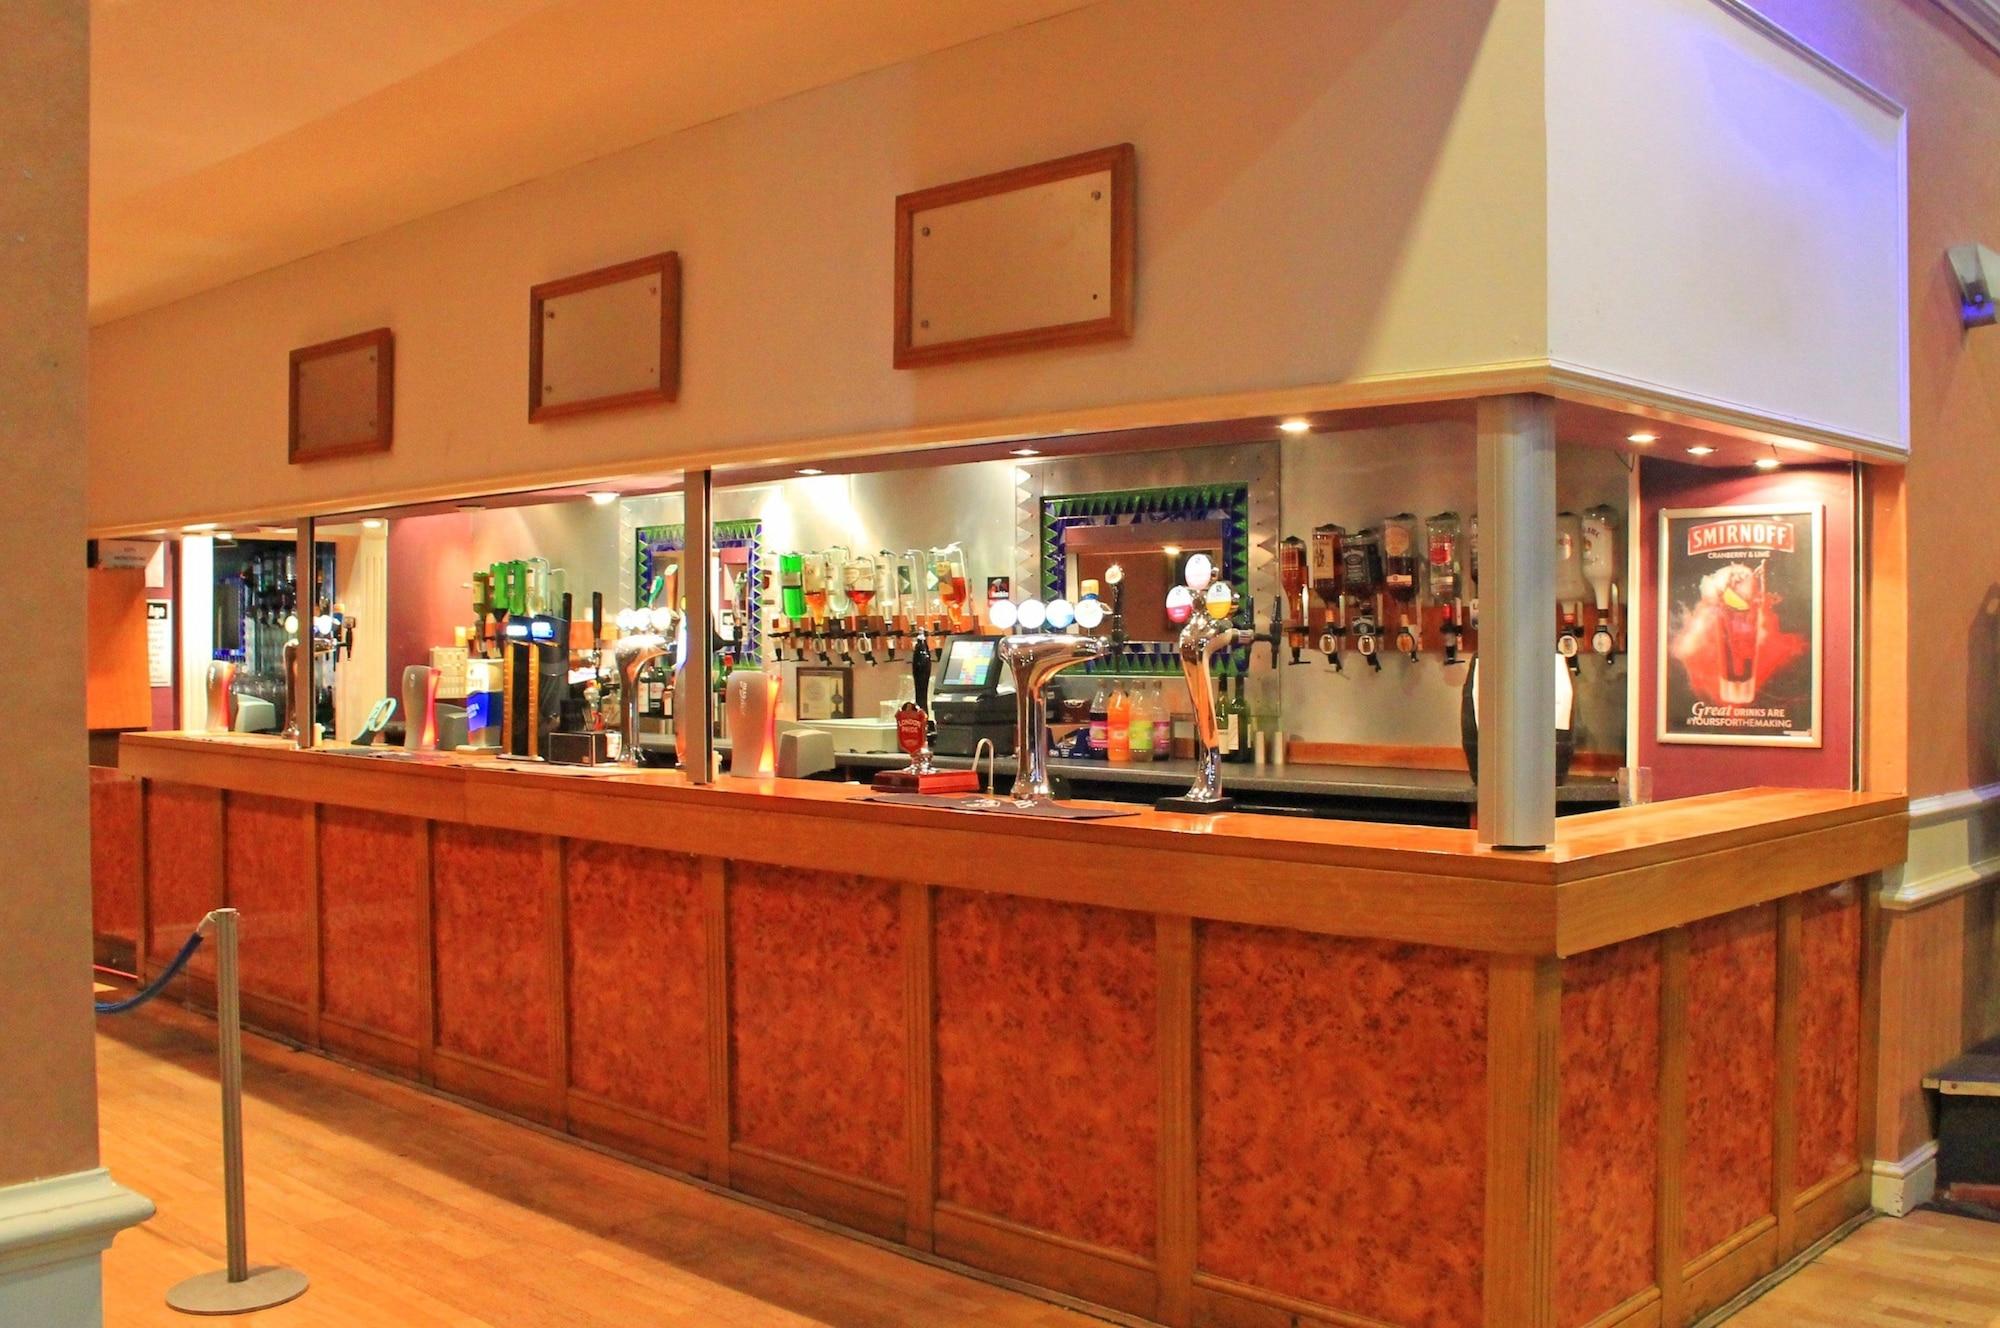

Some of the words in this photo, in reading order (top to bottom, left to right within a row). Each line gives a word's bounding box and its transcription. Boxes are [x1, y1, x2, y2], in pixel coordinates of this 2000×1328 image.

[1693, 523, 1787, 549] SMIRNOFF
[1707, 551, 1747, 559] CRANBERRY
[1754, 550, 1770, 558] LIME
[1691, 701, 1732, 718] Great
[1734, 708, 1766, 717] DRINKS
[1767, 708, 1785, 718] ARE
[897, 719, 921, 728] LONDON
[1686, 717, 1792, 728] #YOURSFORTHEMAKING
